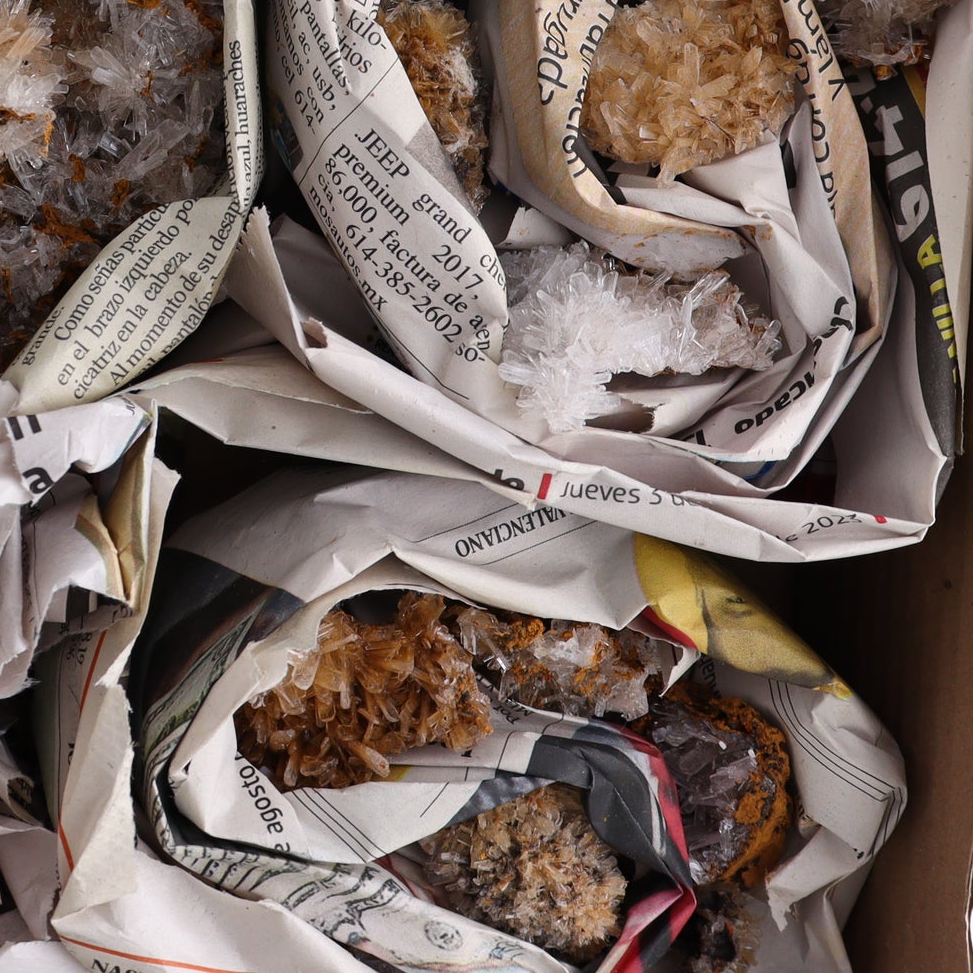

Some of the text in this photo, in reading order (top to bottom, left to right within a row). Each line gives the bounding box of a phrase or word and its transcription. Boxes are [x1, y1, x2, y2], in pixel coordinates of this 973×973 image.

[230, 40, 249, 137] huaraches
[310, 185, 387, 313] mosautos.mx
[317, 174, 463, 344] cia, 614-385-2602
[324, 158, 468, 313] 86,000, factura de
[331, 143, 484, 300] premium 2017,
[411, 193, 472, 253] grand
[53, 250, 125, 341] Como señas
[57, 225, 180, 386] en el brazo izquierdo
[73, 251, 193, 404] cicatriz en la cabeza.
[110, 251, 217, 389] Al momento de su
[560, 481, 641, 504] Jueves
[239, 761, 284, 833] agosto
